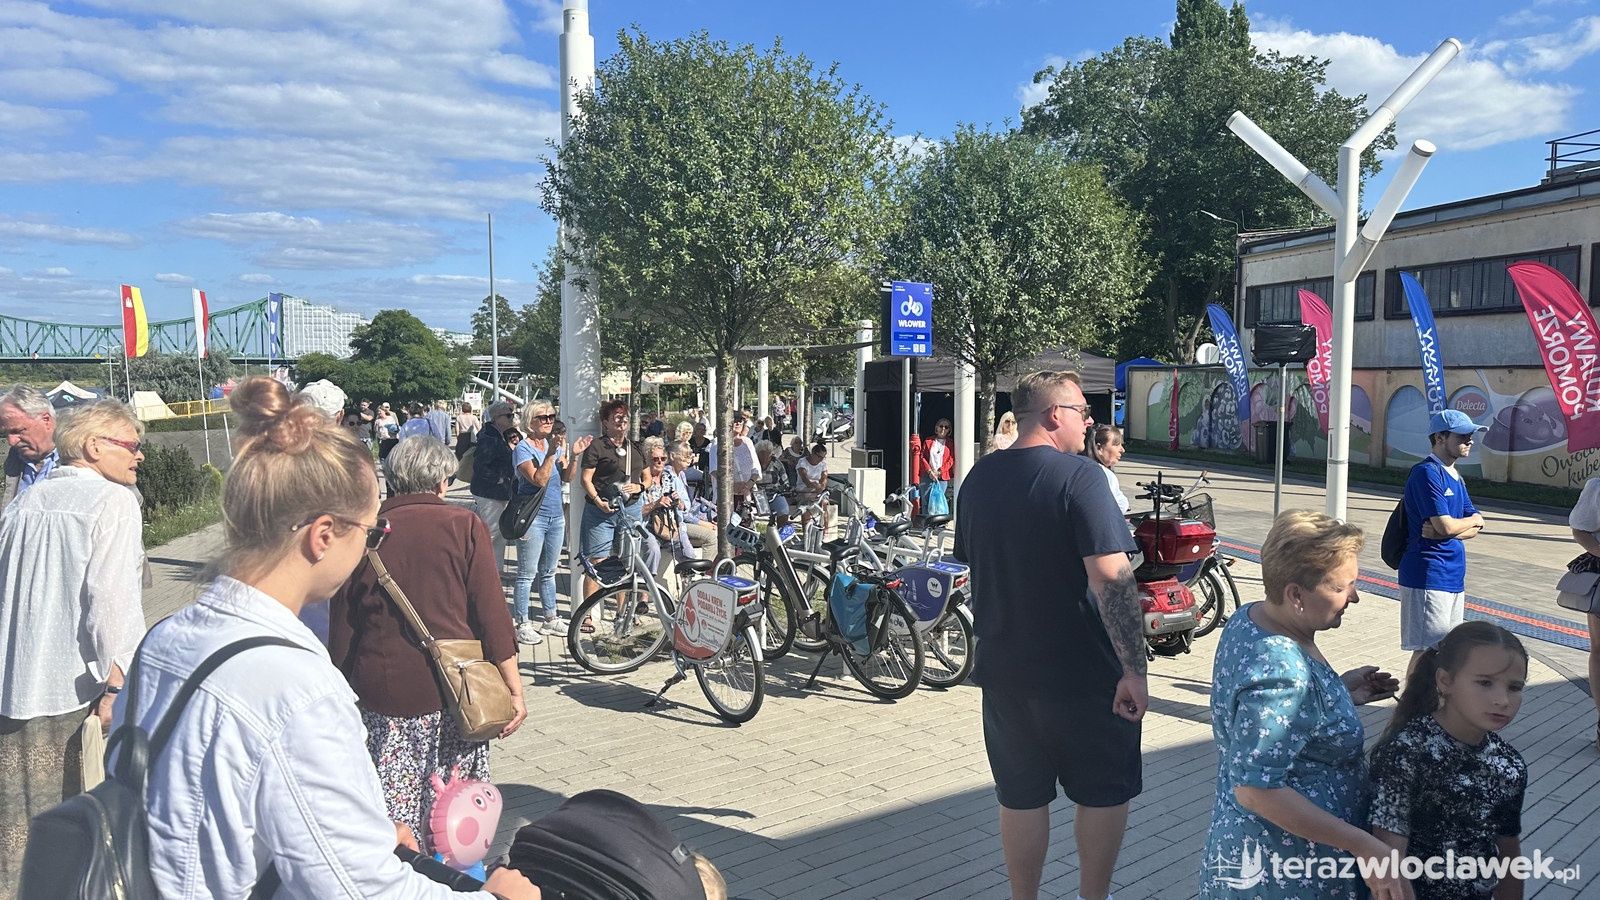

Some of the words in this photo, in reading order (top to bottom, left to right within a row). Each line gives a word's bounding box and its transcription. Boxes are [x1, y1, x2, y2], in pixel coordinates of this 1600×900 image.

[898, 319, 926, 329] WŁOWER
[1456, 399, 1486, 411] Delecta
[1541, 448, 1600, 478] Owoco
